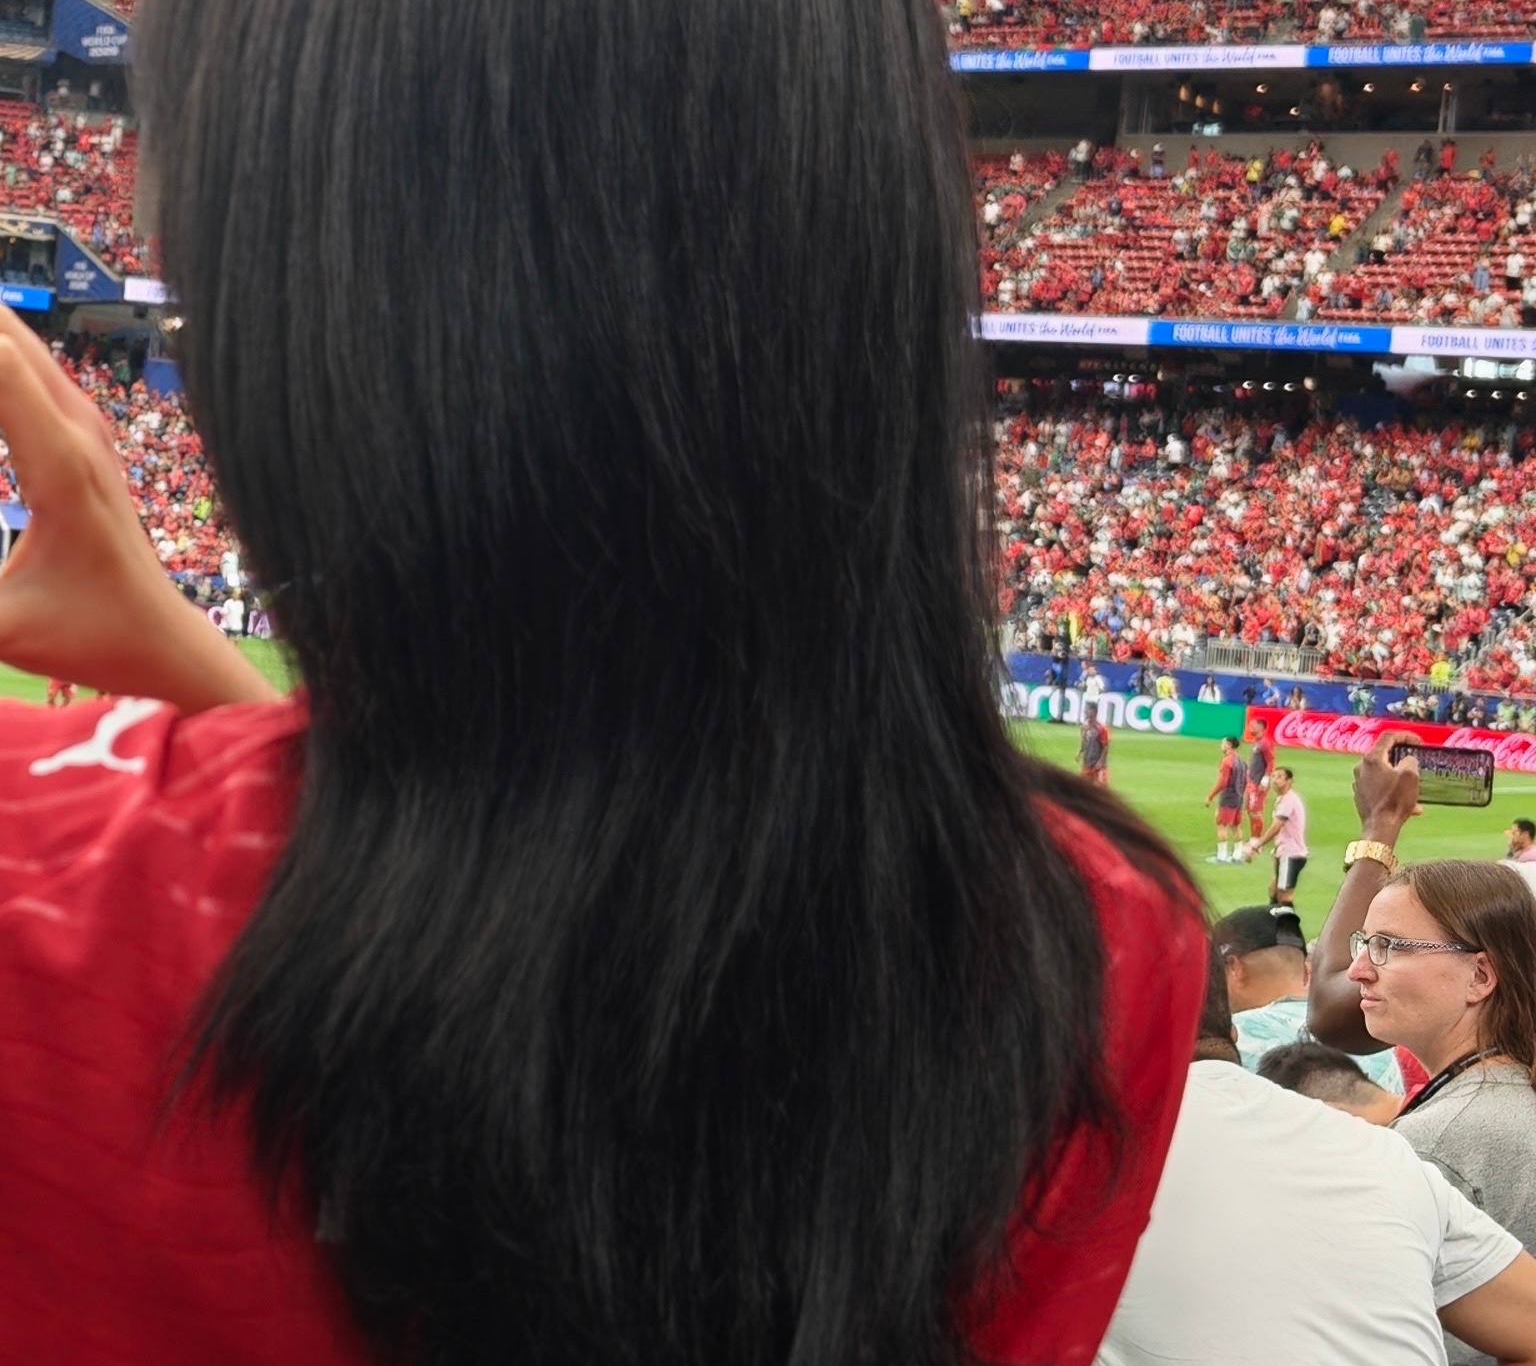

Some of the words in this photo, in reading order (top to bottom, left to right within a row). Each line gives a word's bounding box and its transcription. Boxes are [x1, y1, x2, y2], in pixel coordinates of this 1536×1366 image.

[1328, 47, 1380, 64] FOOTBALL
[1382, 46, 1422, 63] UNITES
[1173, 324, 1230, 344] FOOTBALL
[1231, 326, 1274, 345] UNITES
[1274, 326, 1297, 346] the
[1296, 326, 1338, 348] World
[1420, 333, 1479, 351] FOOTBALL
[1484, 336, 1528, 352] UNITES
